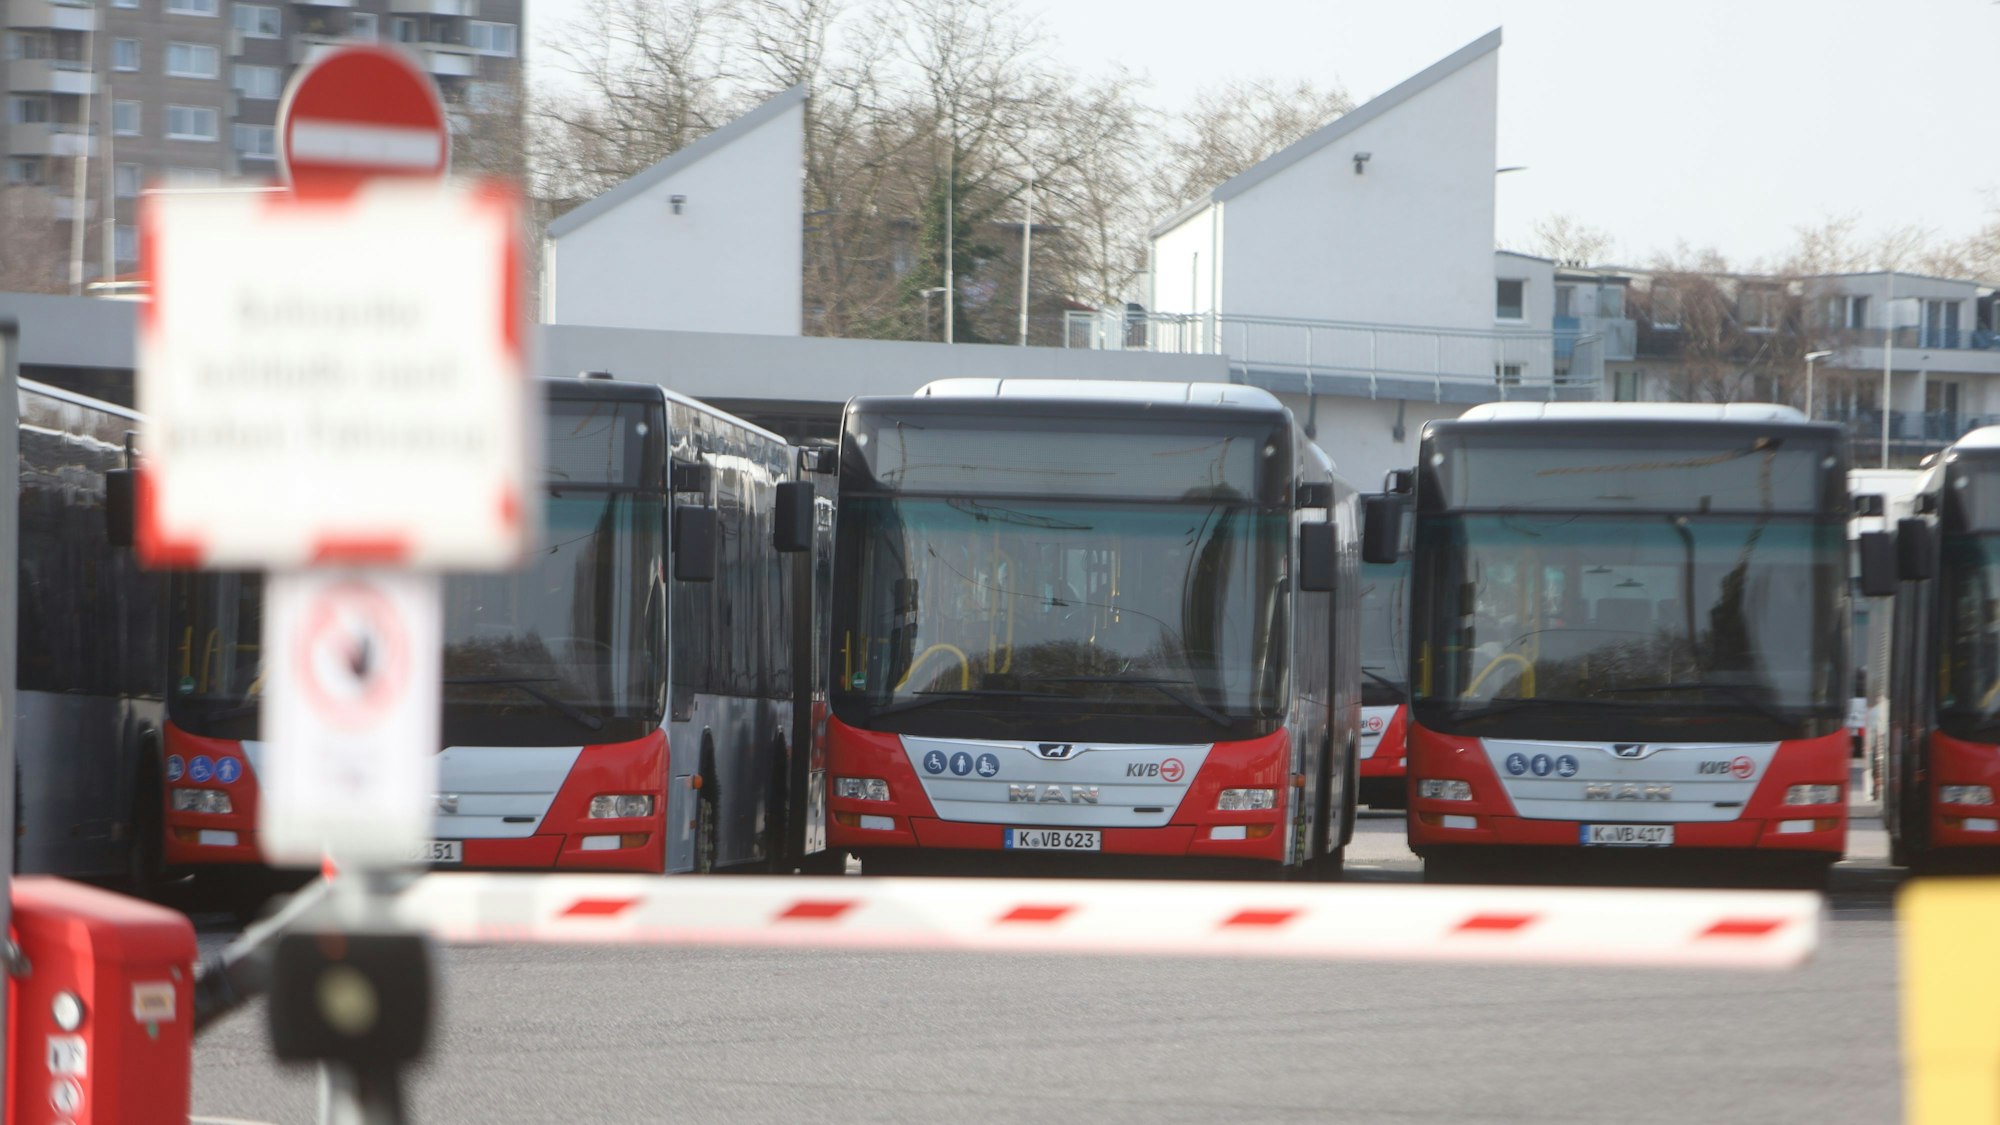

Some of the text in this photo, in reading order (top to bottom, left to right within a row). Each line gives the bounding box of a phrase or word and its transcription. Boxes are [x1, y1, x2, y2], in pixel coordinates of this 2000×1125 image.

[1126, 762, 1159, 777] KVB
[1700, 761, 1732, 775] KVB
[1008, 784, 1099, 804] MAN
[1586, 784, 1672, 800] MAN
[1020, 831, 1094, 848] K VB 623
